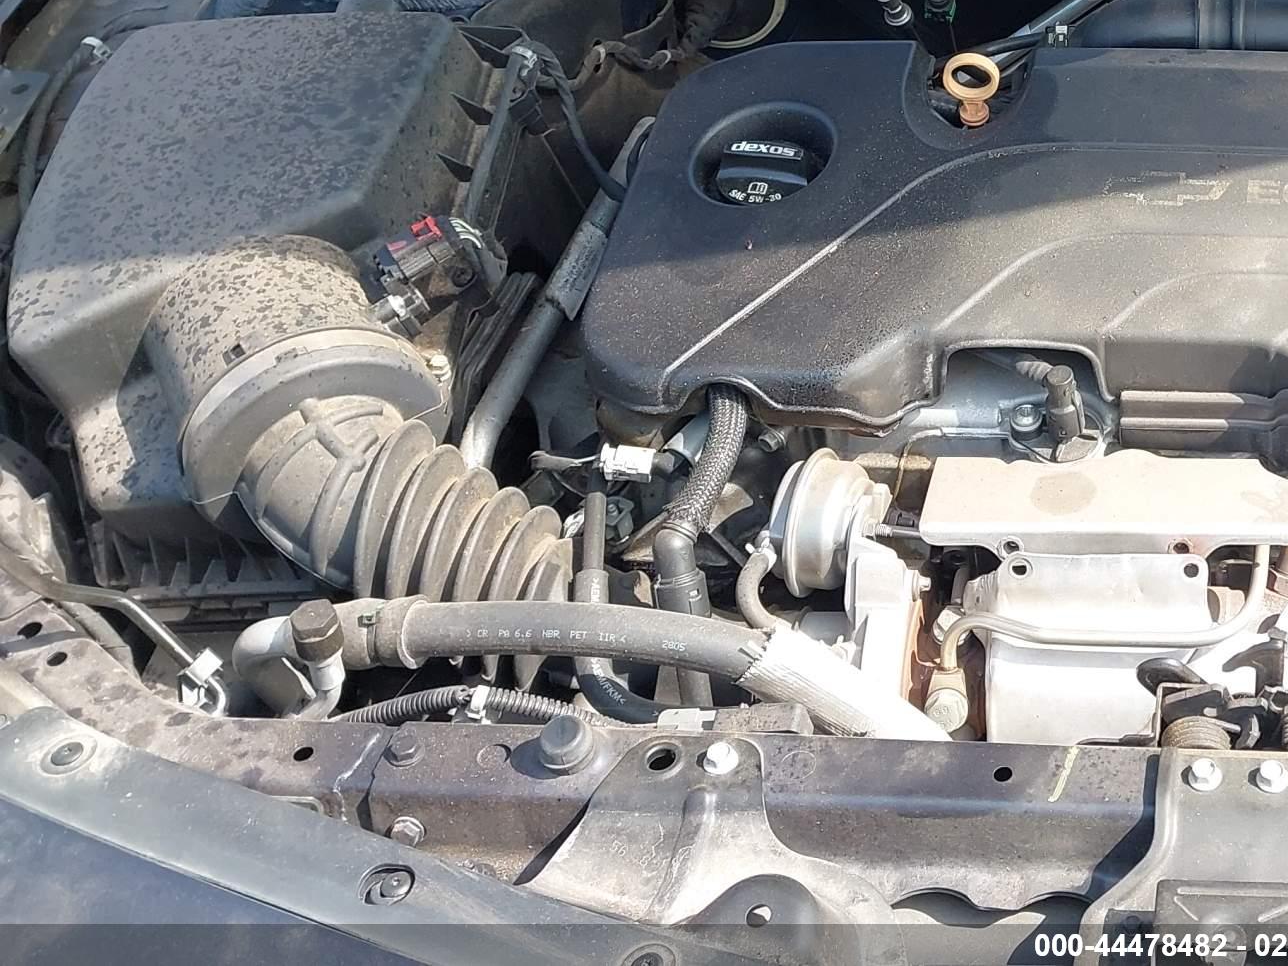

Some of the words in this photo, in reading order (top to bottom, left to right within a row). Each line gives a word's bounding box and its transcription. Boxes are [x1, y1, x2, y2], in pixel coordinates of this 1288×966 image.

[730, 140, 798, 157] dexos
[729, 189, 747, 201] SAE
[748, 193, 782, 203] 5W-30
[569, 630, 588, 641] PET
[599, 631, 615, 643] IIR
